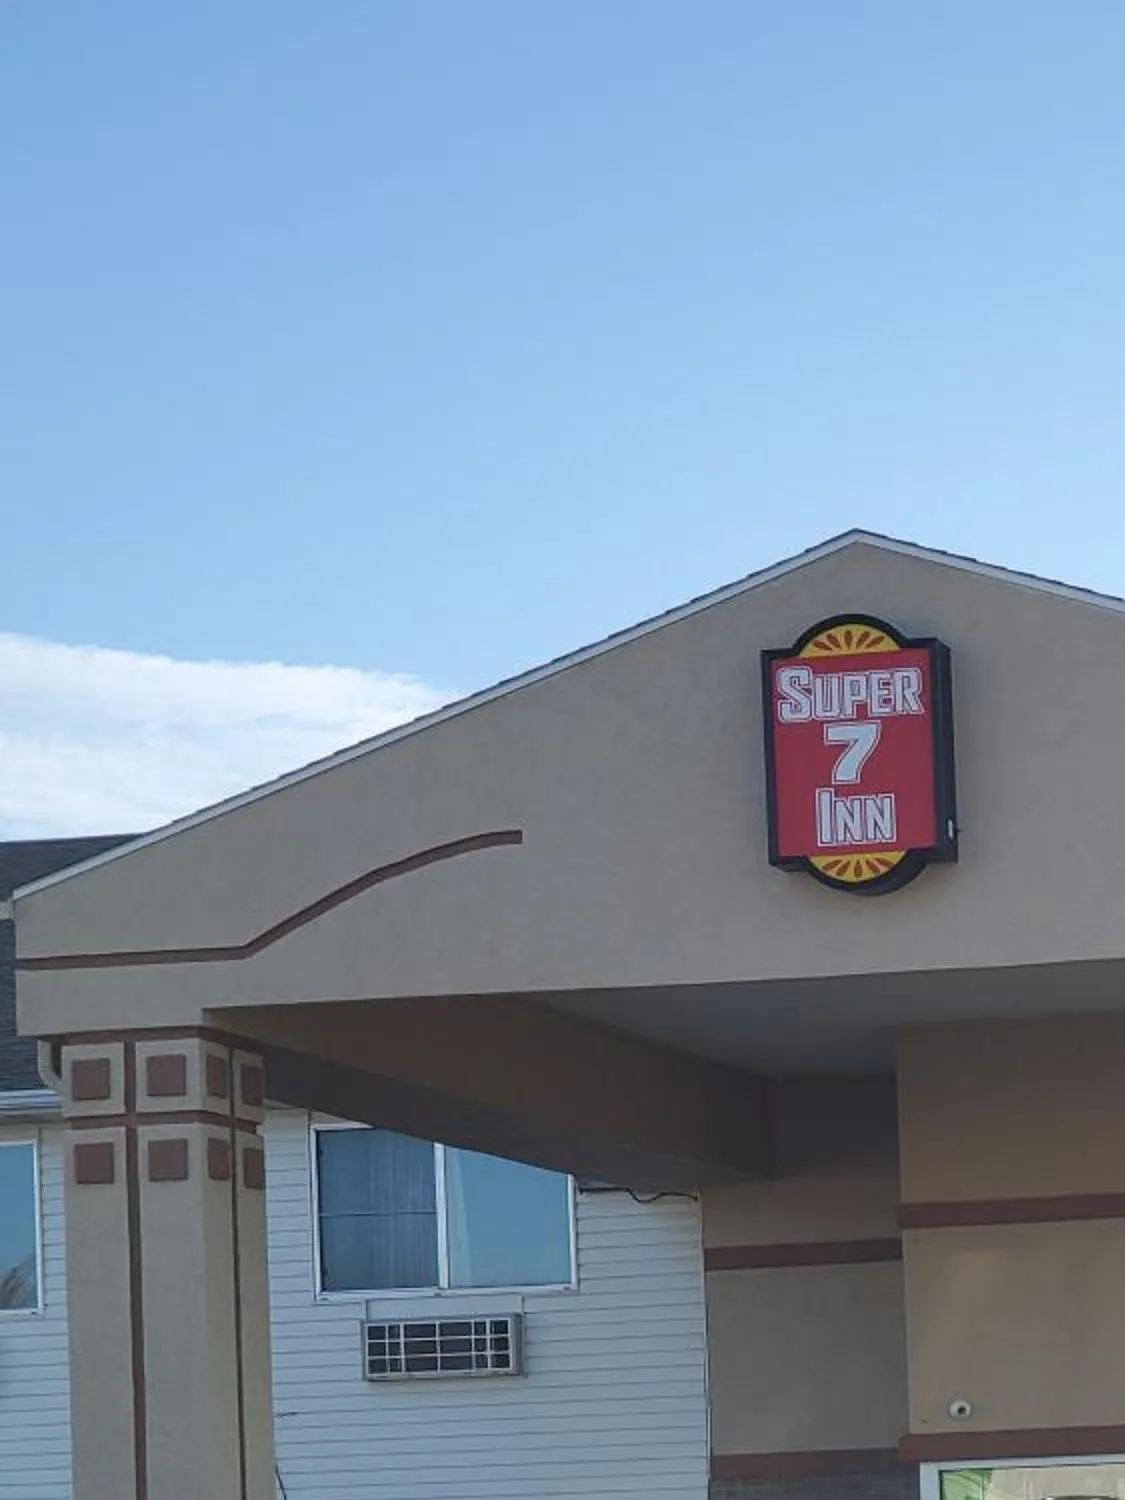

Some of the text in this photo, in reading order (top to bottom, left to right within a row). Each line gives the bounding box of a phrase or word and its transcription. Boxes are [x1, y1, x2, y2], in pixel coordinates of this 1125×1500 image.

[776, 665, 925, 723] SUPER
[824, 720, 881, 784] 7
[816, 787, 896, 847] INN
